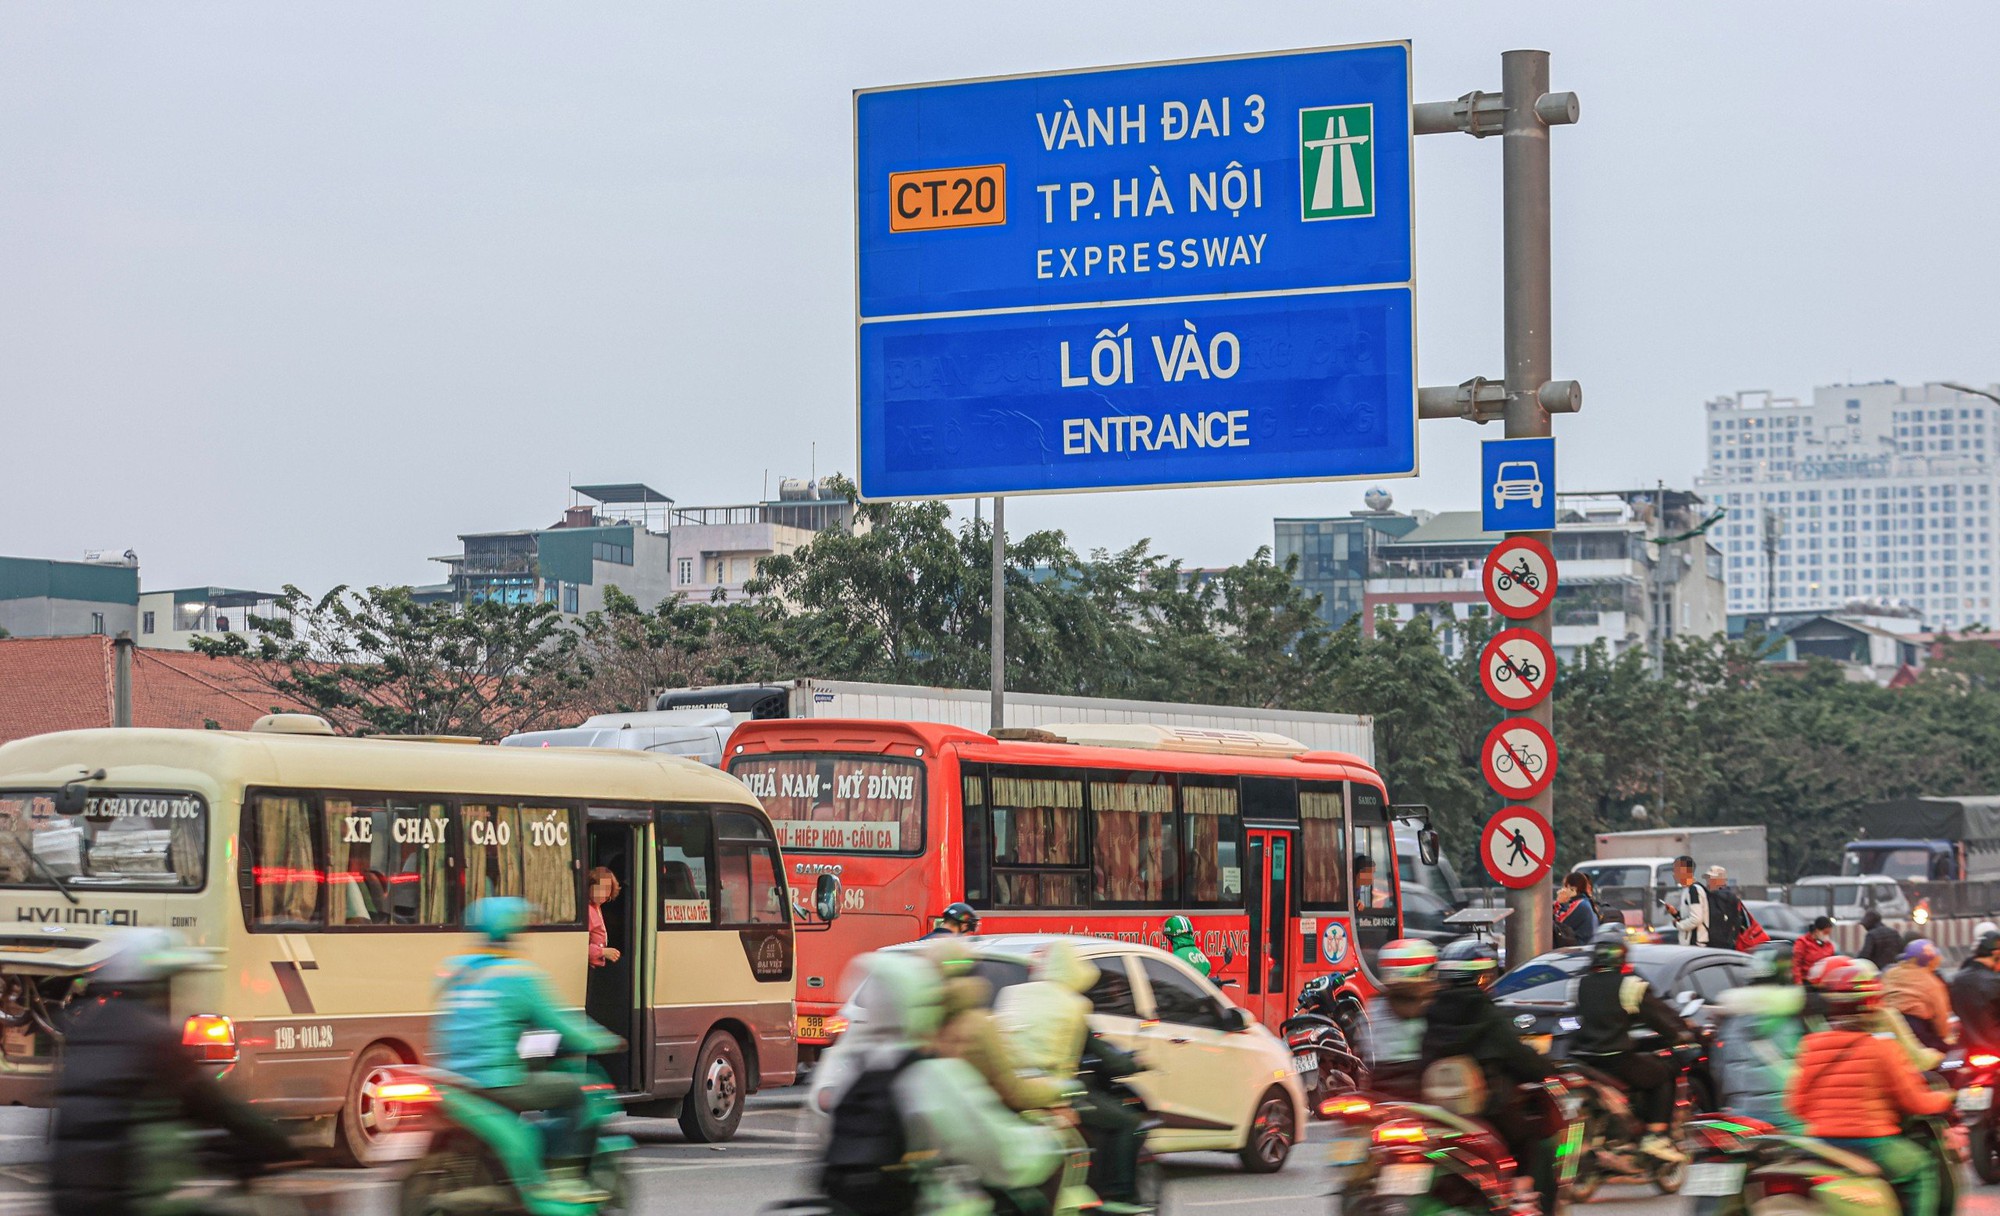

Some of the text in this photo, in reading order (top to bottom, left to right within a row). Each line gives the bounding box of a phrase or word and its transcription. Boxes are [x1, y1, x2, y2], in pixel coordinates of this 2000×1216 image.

[1036, 94, 1266, 151] VÀNH ĐAI 3
[896, 176, 997, 220] CT.20
[1190, 161, 1263, 217] NỘI
[1037, 233, 1268, 279] EXPRESSWAY
[1060, 322, 1134, 388] LỐI
[1151, 319, 1241, 382] VÀO
[1063, 410, 1250, 455] ENTRANCE
[707, 702, 729, 710] KING
[781, 774, 820, 798] NAM
[837, 769, 866, 799] MỸ
[100, 798, 140, 821] CHẠY
[139, 799, 168, 818] CAO
[343, 810, 568, 849] XE CHẠY CAO TỐC
[852, 824, 874, 849] CẦU
[876, 830, 893, 849] CA
[795, 863, 843, 874] SAMCO
[172, 916, 197, 927] COUNTY
[1203, 929, 1249, 957] GIANG
[807, 1017, 823, 1027] 98B
